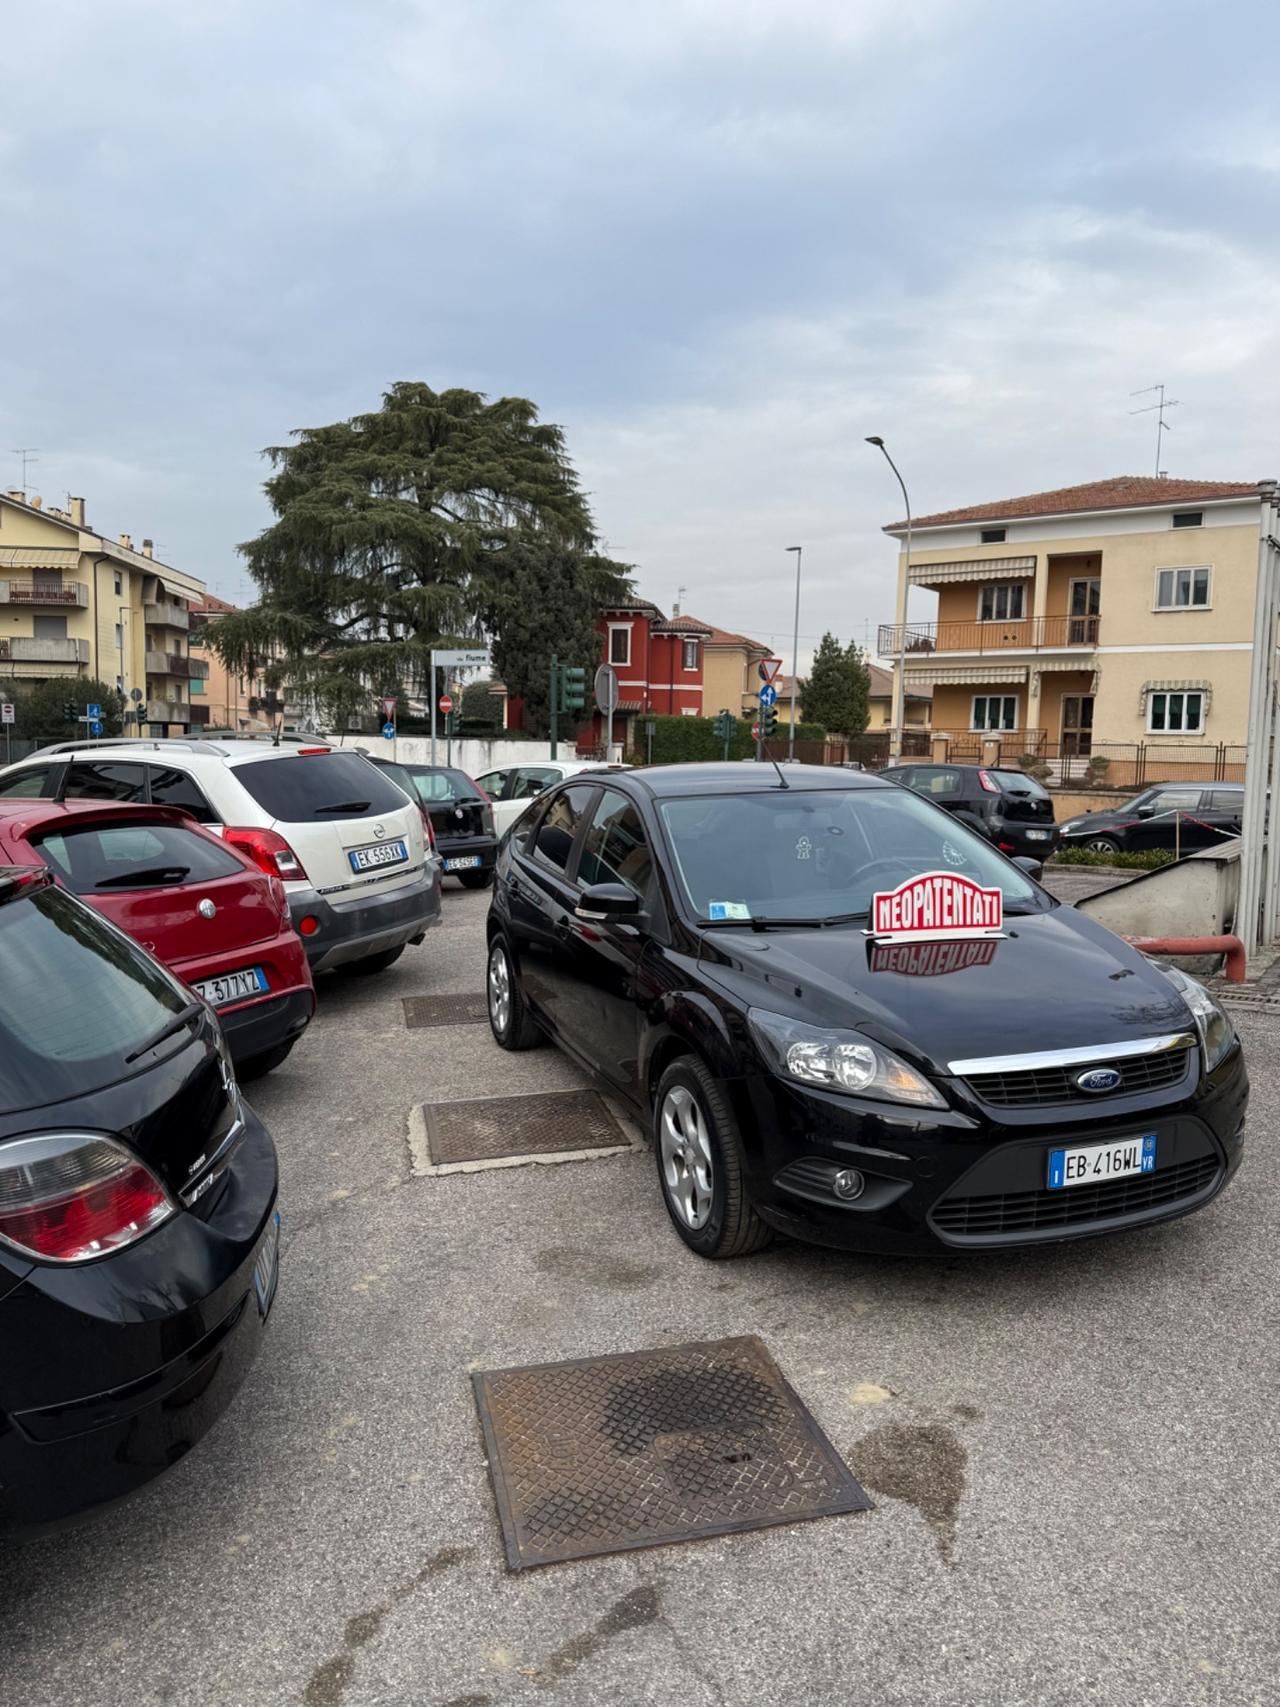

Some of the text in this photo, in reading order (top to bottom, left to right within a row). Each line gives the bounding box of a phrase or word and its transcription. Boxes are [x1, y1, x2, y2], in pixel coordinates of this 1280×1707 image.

[358, 844, 401, 867] EK 556XK
[879, 876, 999, 930] NEOPATENTATI
[211, 971, 260, 1001] 377YZ
[1090, 1073, 1113, 1088] Ford
[1066, 1155, 1087, 1179] EB
[1093, 1146, 1141, 1175] 416WL
[1143, 1155, 1153, 1170] VR
